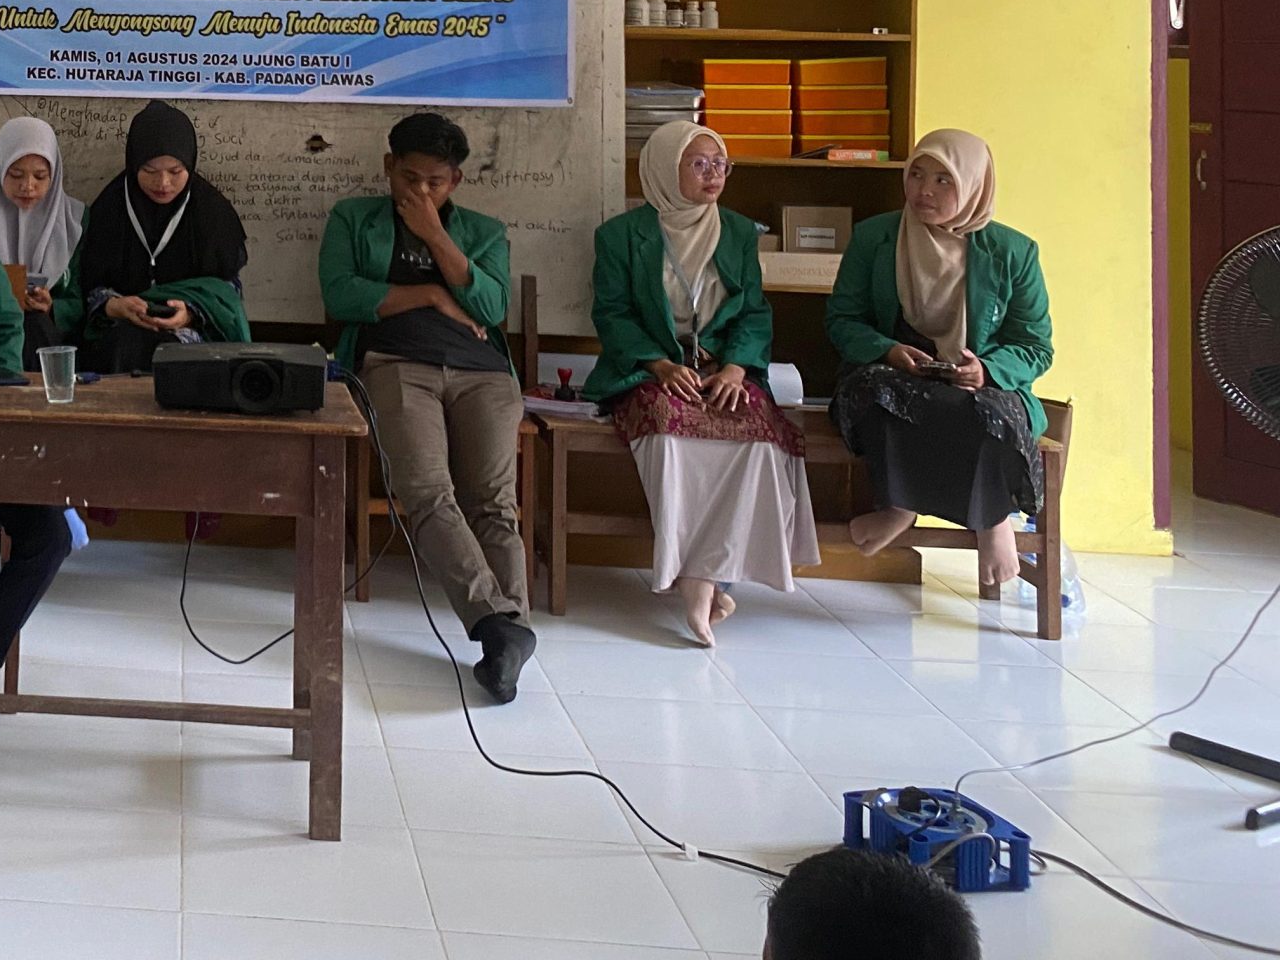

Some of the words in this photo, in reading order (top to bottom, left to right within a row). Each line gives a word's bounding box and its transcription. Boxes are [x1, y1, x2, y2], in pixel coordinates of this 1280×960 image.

[60, 7, 195, 36] Menyongsong
[199, 10, 282, 38] Menuju
[283, 12, 379, 38] Indonesia
[384, 13, 439, 38] Emas
[442, 15, 492, 38] 2045
[49, 50, 101, 64] KAMIS,
[105, 51, 122, 63] 01
[127, 52, 198, 65] AGUSTUS
[202, 53, 238, 66] 2024
[242, 54, 295, 67] UJUNG
[300, 55, 340, 68] BATU
[345, 55, 351, 68] I
[26, 67, 61, 80] KEC.
[66, 68, 144, 82] HUTARAJA
[148, 70, 200, 83] TINGGI
[214, 72, 250, 85] KAB.
[255, 73, 316, 86] PADANG
[321, 74, 375, 87] LAWAS
